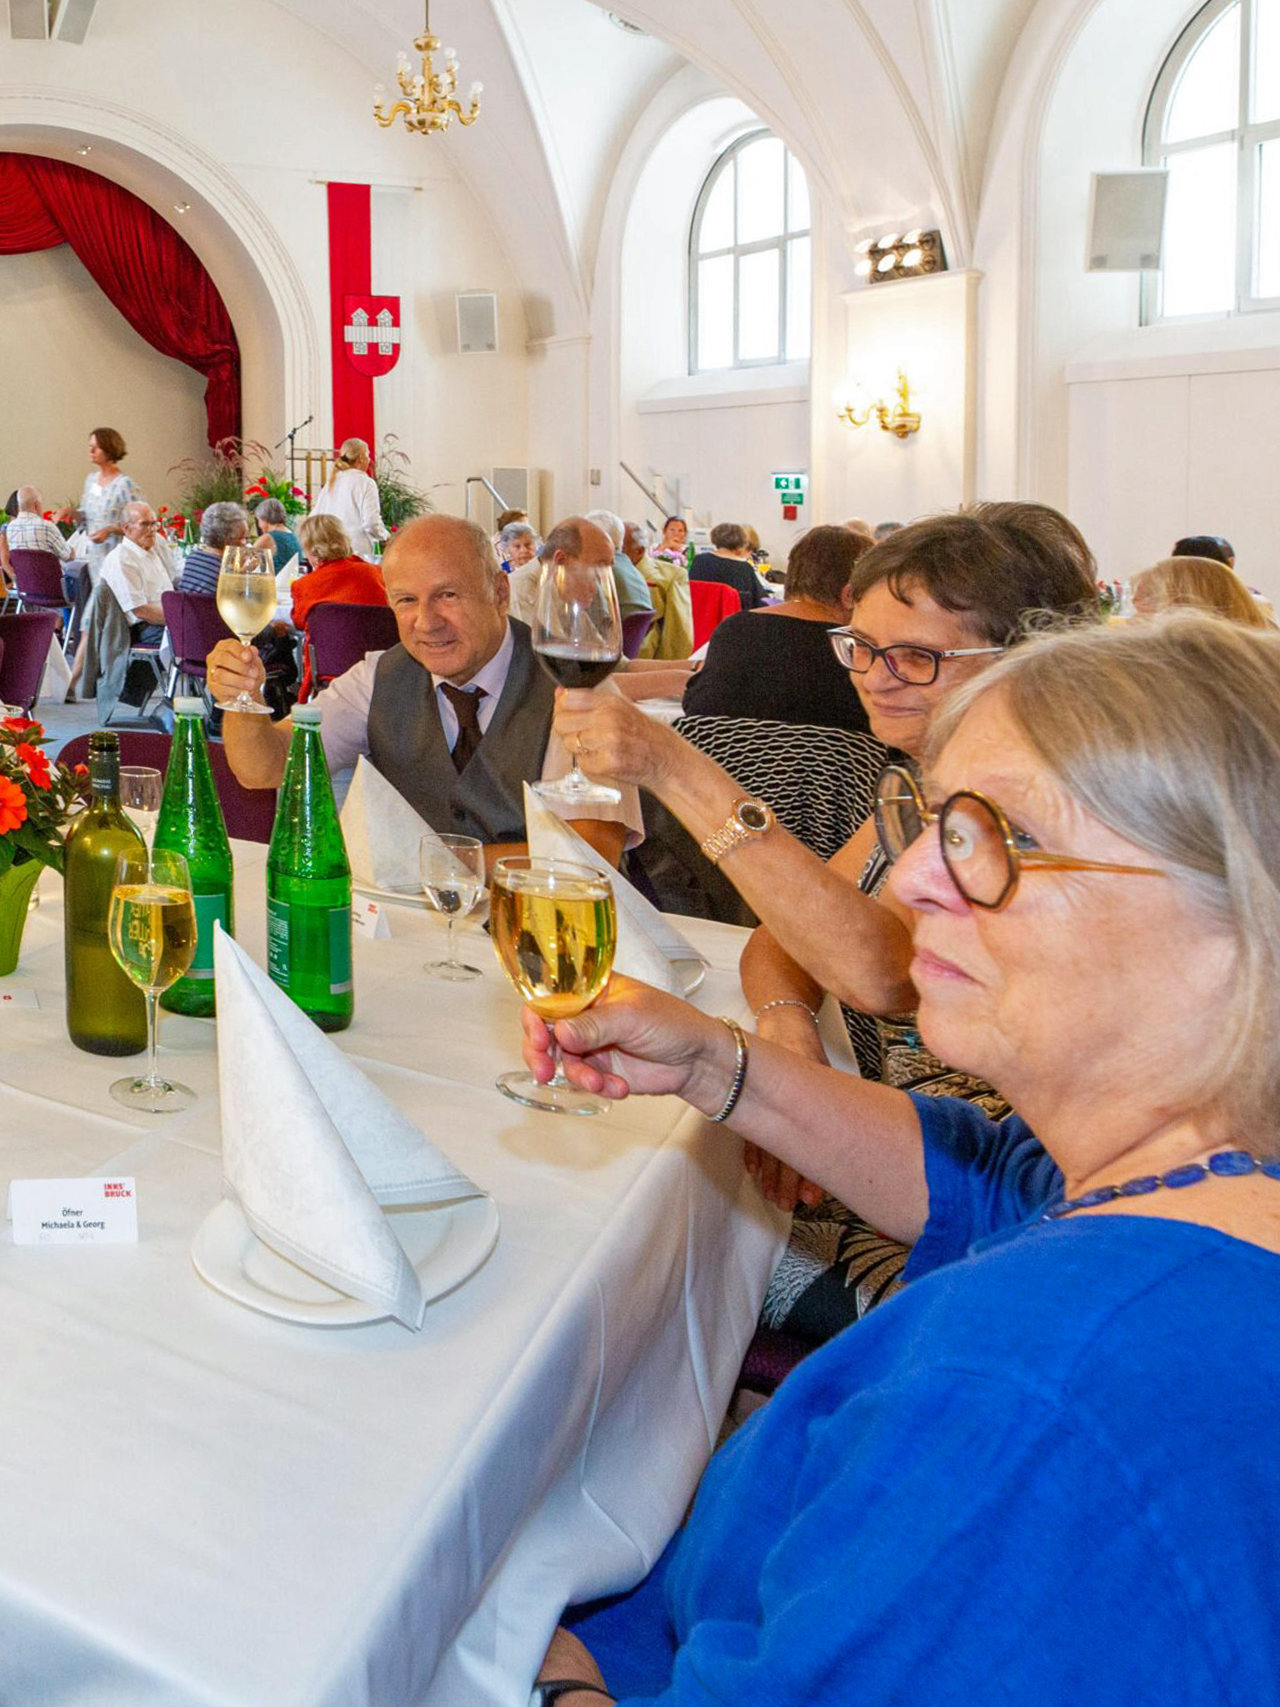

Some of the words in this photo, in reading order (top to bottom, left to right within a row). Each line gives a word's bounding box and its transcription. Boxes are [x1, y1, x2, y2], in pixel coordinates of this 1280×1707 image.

[62, 1207, 83, 1217] Öfner
[41, 1220, 75, 1230] Michaela
[76, 1220, 82, 1229] &
[83, 1220, 105, 1230] Georg
